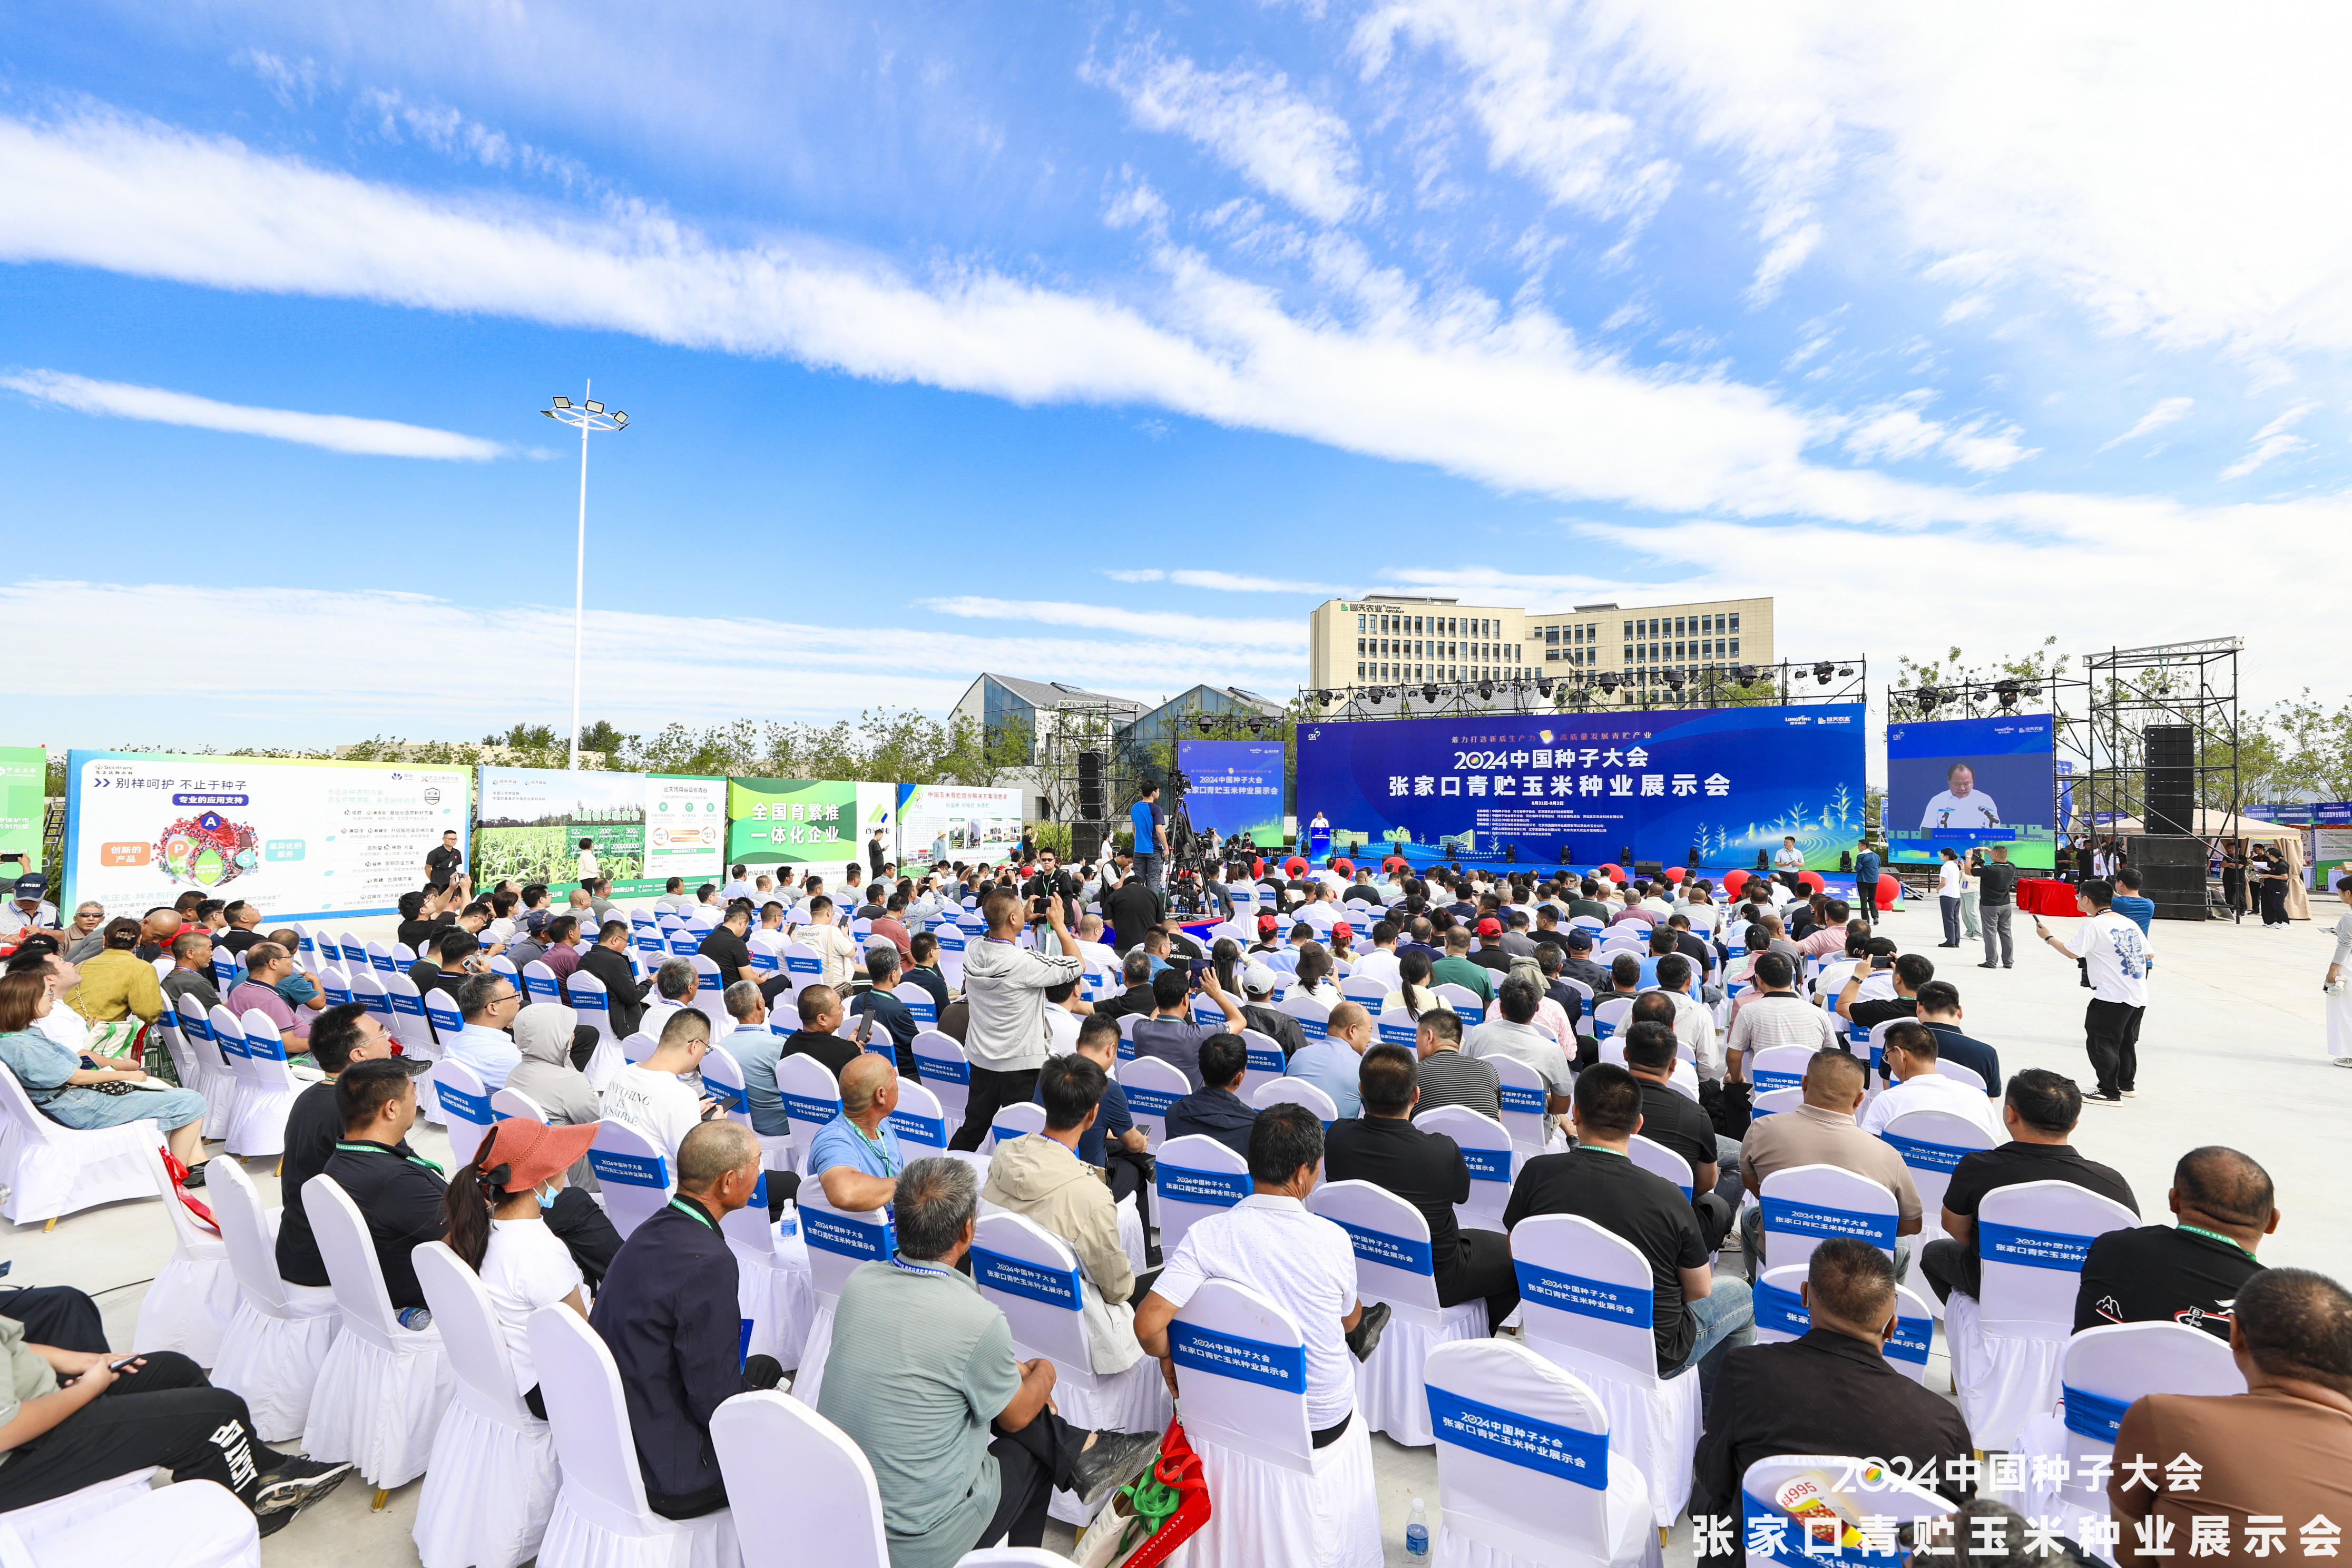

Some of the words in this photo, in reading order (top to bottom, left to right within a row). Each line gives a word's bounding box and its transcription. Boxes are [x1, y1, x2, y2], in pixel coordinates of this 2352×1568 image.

[1350, 604, 1382, 612] 巡天农业
[1452, 734, 1536, 743] 着力打造新质生产力
[1560, 731, 1652, 741] 高质量发展青贮产业
[1454, 746, 1649, 770] 2024中国种子大会
[115, 778, 174, 789] 别样呵护
[180, 779, 247, 791] 不止于种子
[1389, 772, 1730, 797] 张家口青贮玉米种业展示会
[178, 796, 243, 805] 专业的应用支持
[571, 810, 640, 821] 饲用谷草张青谷
[751, 801, 840, 822] 全国育繁推
[206, 817, 216, 826] A
[751, 826, 840, 845] 一体化企业
[111, 846, 141, 854] 创新的
[174, 845, 183, 853] P
[115, 855, 136, 864] 产品
[241, 855, 250, 864] S
[616, 1098, 624, 1108] IS
[601, 1159, 642, 1171] 2024中国种子大会
[1166, 1182, 1244, 1199] 张家口青贮玉米种业展示会
[1177, 1176, 1231, 1189] 2024中国种子大会
[1775, 1216, 1883, 1238] 张家口青贮玉米种业展示会
[1791, 1211, 1868, 1227] 2024中国种子大会
[815, 1221, 864, 1239] 2024中国种子大会
[996, 1262, 1057, 1284] 2024中国种子大会
[987, 1269, 1071, 1298] 张家口青贮玉米种业展示会
[1541, 1278, 1618, 1301] 2024中国种子大会
[1528, 1283, 1634, 1314] 张家口青贮玉米种业展示会
[1193, 1337, 1270, 1363] 2024中国种子大会
[1179, 1344, 1289, 1379] 张家口青贮玉米种业展示会
[1461, 1412, 1563, 1448] 2024中国种子大会
[1443, 1416, 1586, 1468] 张家口青贮玉米种业展示会
